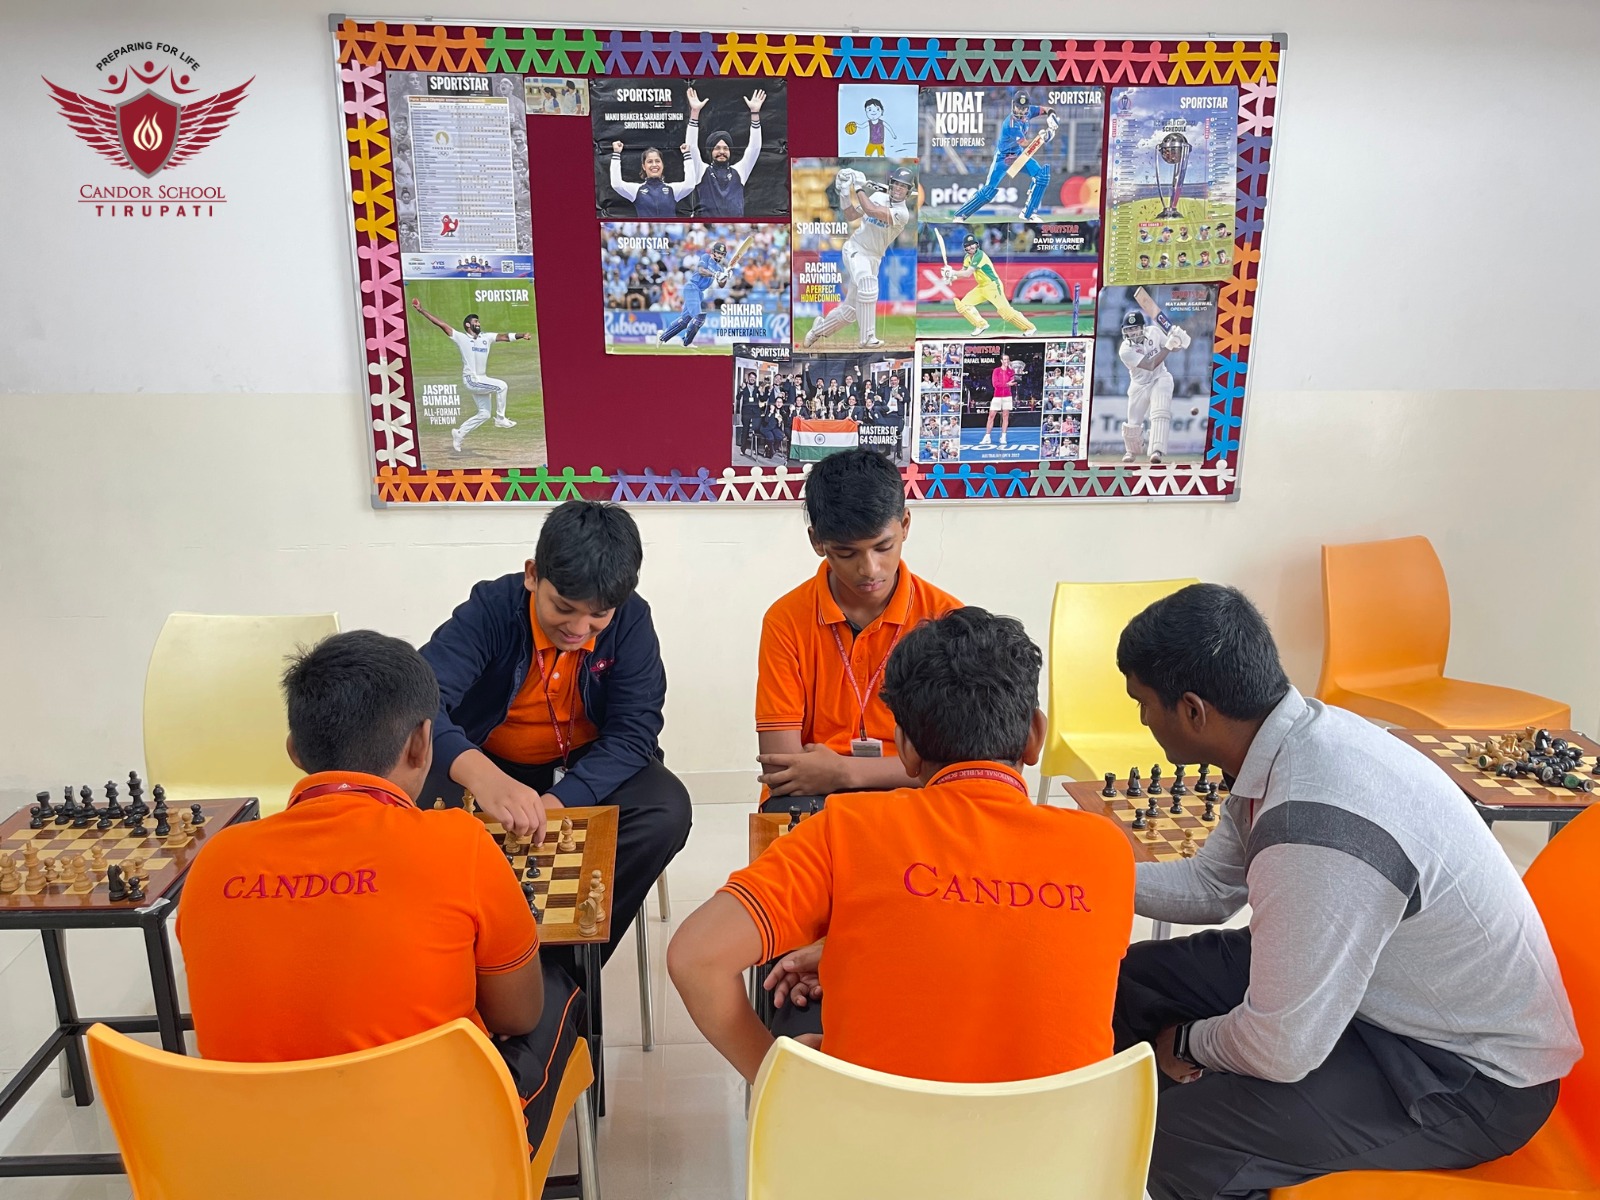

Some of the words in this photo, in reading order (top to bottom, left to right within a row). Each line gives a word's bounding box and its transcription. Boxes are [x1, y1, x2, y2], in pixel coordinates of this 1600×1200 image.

[430, 76, 489, 90] SPORTSTAR
[616, 88, 672, 102] SPORTSTAR
[1048, 91, 1102, 105] SPORTSTAR
[935, 91, 984, 113] VIRAT
[1180, 96, 1228, 109] SPORTSTAR
[935, 113, 983, 134] KOHLI
[932, 138, 951, 147] STUFF
[952, 138, 959, 147] OF
[959, 138, 985, 147] DREAMS
[931, 183, 1018, 208] pricss
[796, 222, 848, 235] SPORTSTAR
[1041, 224, 1079, 234] SPORTSTAR
[618, 237, 669, 250] SPORTSTAR
[805, 262, 837, 273] RACHIN
[800, 273, 842, 284] RAVINDRA
[806, 285, 810, 293] A
[811, 285, 836, 293] PERFECT
[475, 289, 529, 302] SPORTSTAR
[800, 294, 841, 302] HOMECOMING
[720, 304, 762, 316] SHIKHAR
[720, 316, 762, 328] DHAWAN
[716, 329, 727, 337] TOP
[727, 329, 767, 337] ENTERTAINER
[751, 347, 790, 357] SPORTSTAR
[965, 346, 1000, 354] SPORTSTAR
[423, 384, 457, 395] JASPRIT
[422, 395, 460, 406] BUMRAH
[424, 408, 460, 416] ALL-FORMAT
[430, 416, 456, 425] PHENOM
[860, 426, 890, 435] MASTERS
[890, 426, 898, 435] OF
[860, 435, 868, 444] 64
[869, 435, 898, 445] SQUARES
[223, 869, 378, 899] CANDOR
[904, 862, 1091, 912] CANDOR
